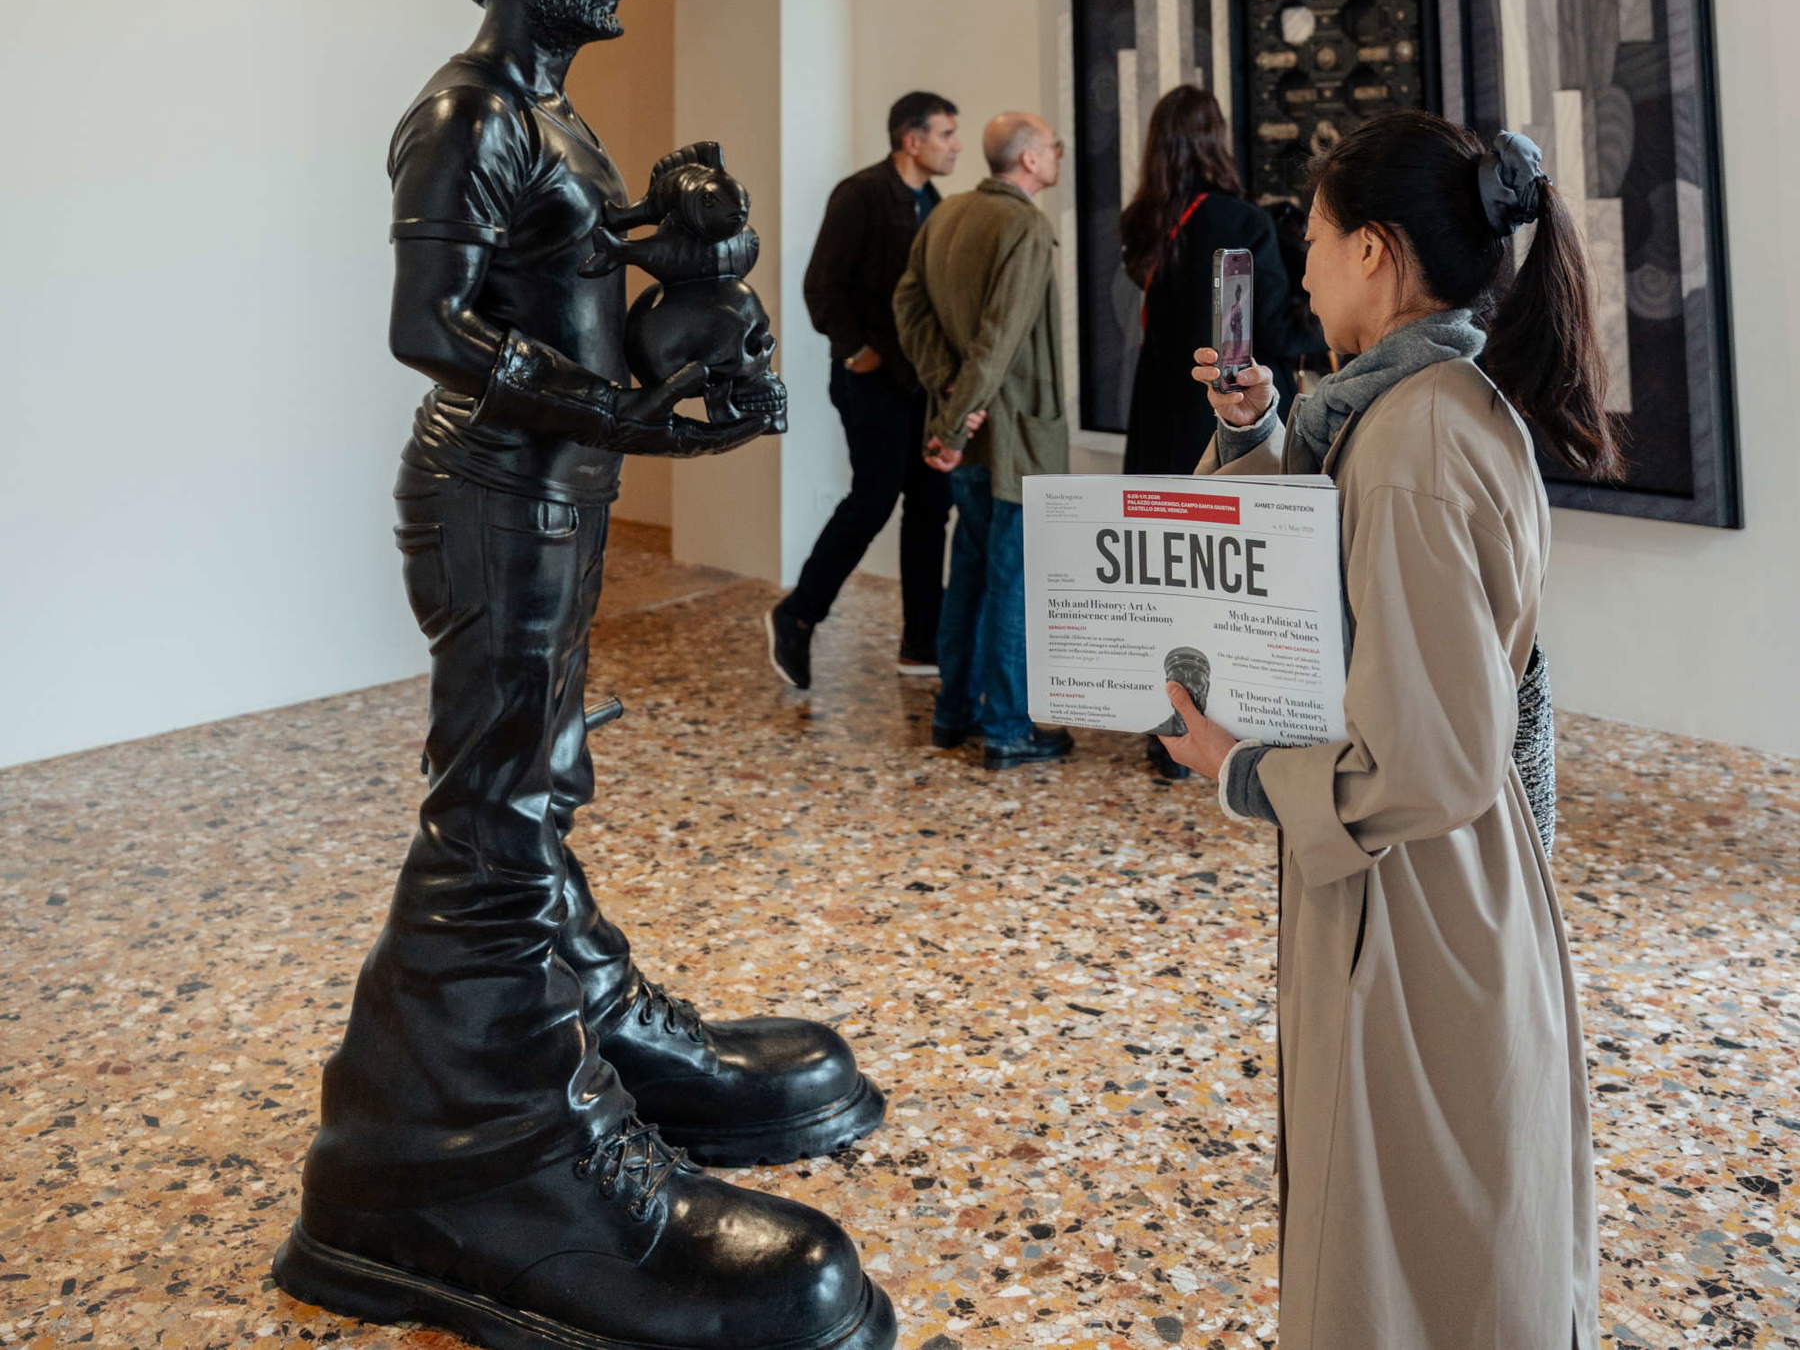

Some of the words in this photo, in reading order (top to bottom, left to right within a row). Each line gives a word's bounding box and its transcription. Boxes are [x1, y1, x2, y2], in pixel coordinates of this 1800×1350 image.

[1096, 528, 1268, 597] SILENCE
[1048, 599, 1071, 611] Myth
[1073, 600, 1089, 609] and
[1128, 602, 1143, 610] Art
[1145, 602, 1158, 611] As
[1048, 610, 1109, 620] Reminiscence
[1111, 612, 1127, 621] and
[1128, 612, 1174, 626] Testimony
[1228, 610, 1250, 623] Myth
[1266, 615, 1302, 629] Political
[1303, 620, 1319, 631] Act
[1213, 621, 1229, 631] and
[1229, 622, 1242, 632] the
[1244, 624, 1278, 639] Memory
[1279, 630, 1288, 638] of
[1290, 631, 1320, 642] Stones
[1049, 676, 1067, 686] The
[1068, 677, 1095, 688] Doors
[1096, 678, 1106, 688] of
[1107, 679, 1155, 690] Resistance
[1229, 688, 1245, 699] The
[1246, 690, 1272, 703] Doors
[1273, 695, 1283, 704] of
[1284, 697, 1325, 710] Anatolia:
[1238, 702, 1285, 717] Threshold,
[1286, 708, 1326, 722] Memory,
[1238, 715, 1254, 724] and
[1255, 718, 1265, 726] an
[1268, 719, 1328, 733] Architectural
[1280, 729, 1329, 744] Cosmology
